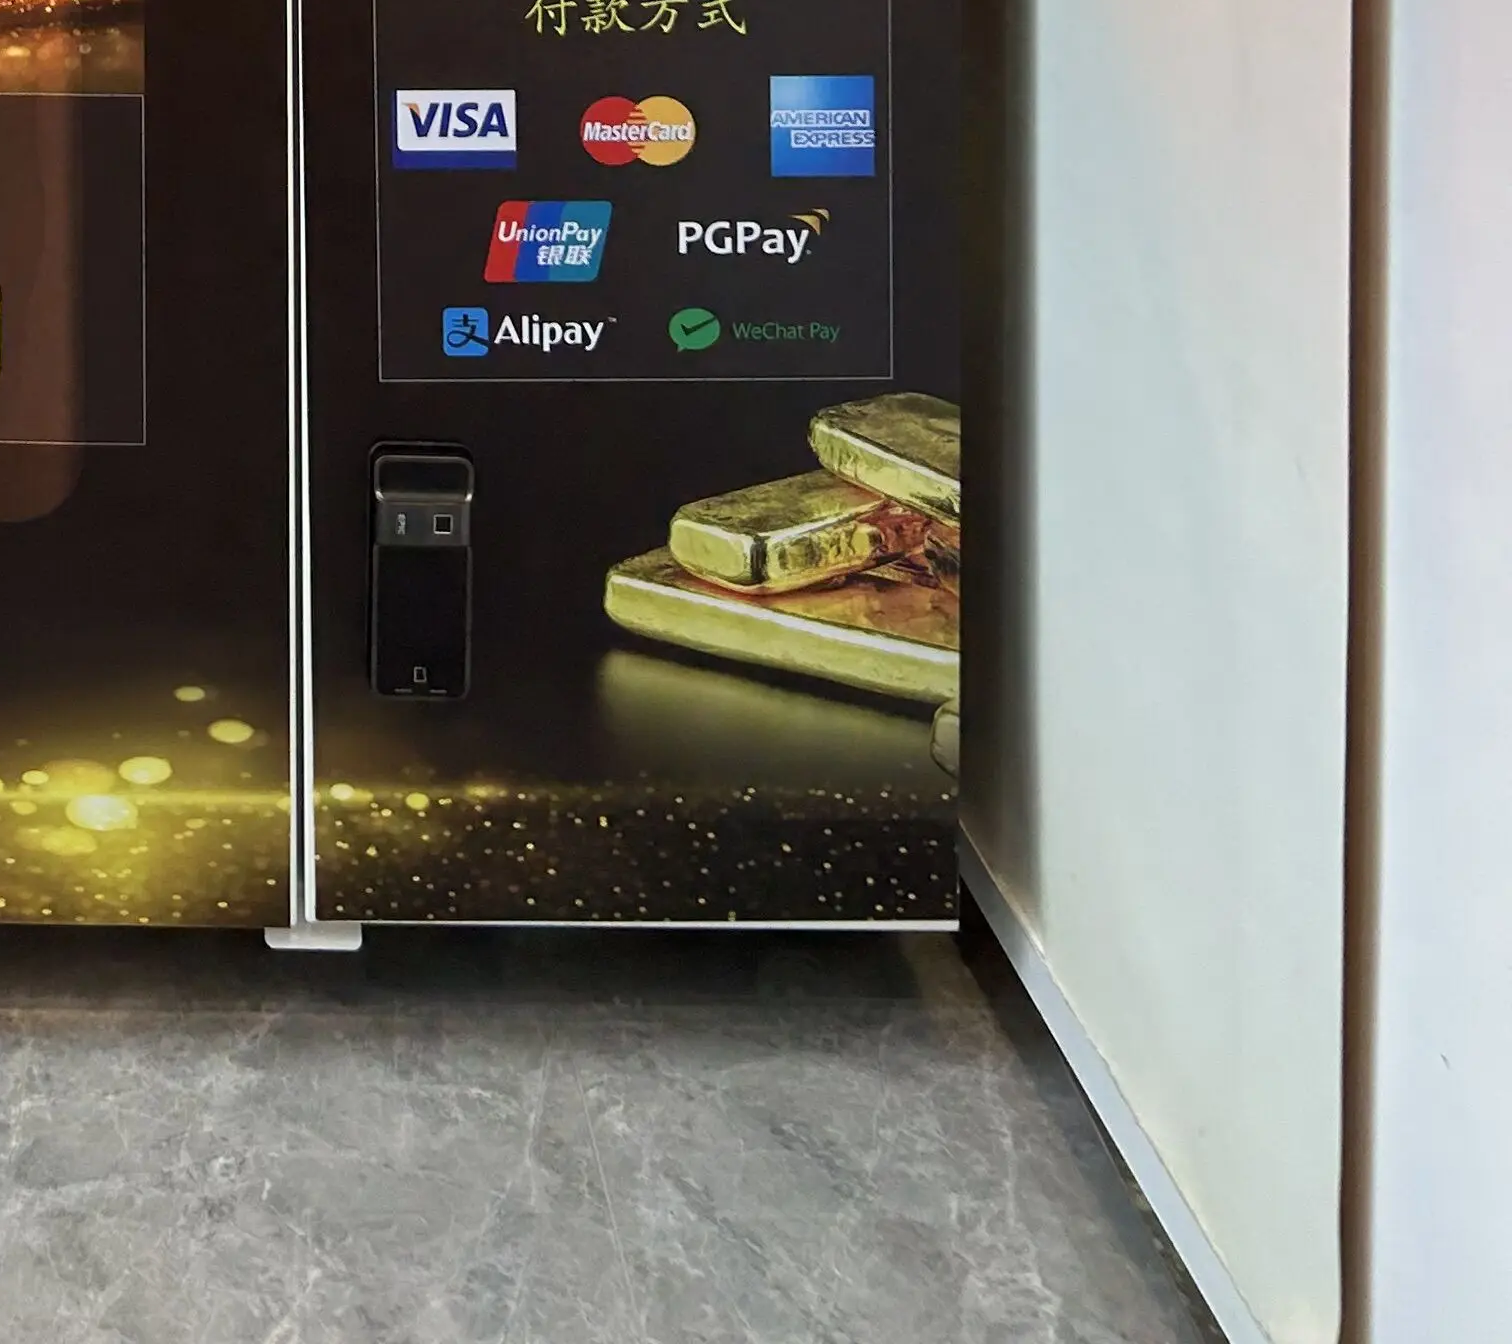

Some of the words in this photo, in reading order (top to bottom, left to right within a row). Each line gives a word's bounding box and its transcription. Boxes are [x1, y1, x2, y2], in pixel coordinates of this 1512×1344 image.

[402, 101, 510, 139] VISA
[771, 110, 868, 127] AMERICAN
[582, 120, 695, 143] MasterCard
[792, 130, 875, 148] EXPRESS
[497, 220, 602, 246] UnionPay
[677, 220, 810, 264] PGPay
[536, 244, 592, 267] 银联
[494, 314, 604, 352] Alipay
[733, 322, 804, 341] WeChat
[810, 322, 840, 344] Pay
